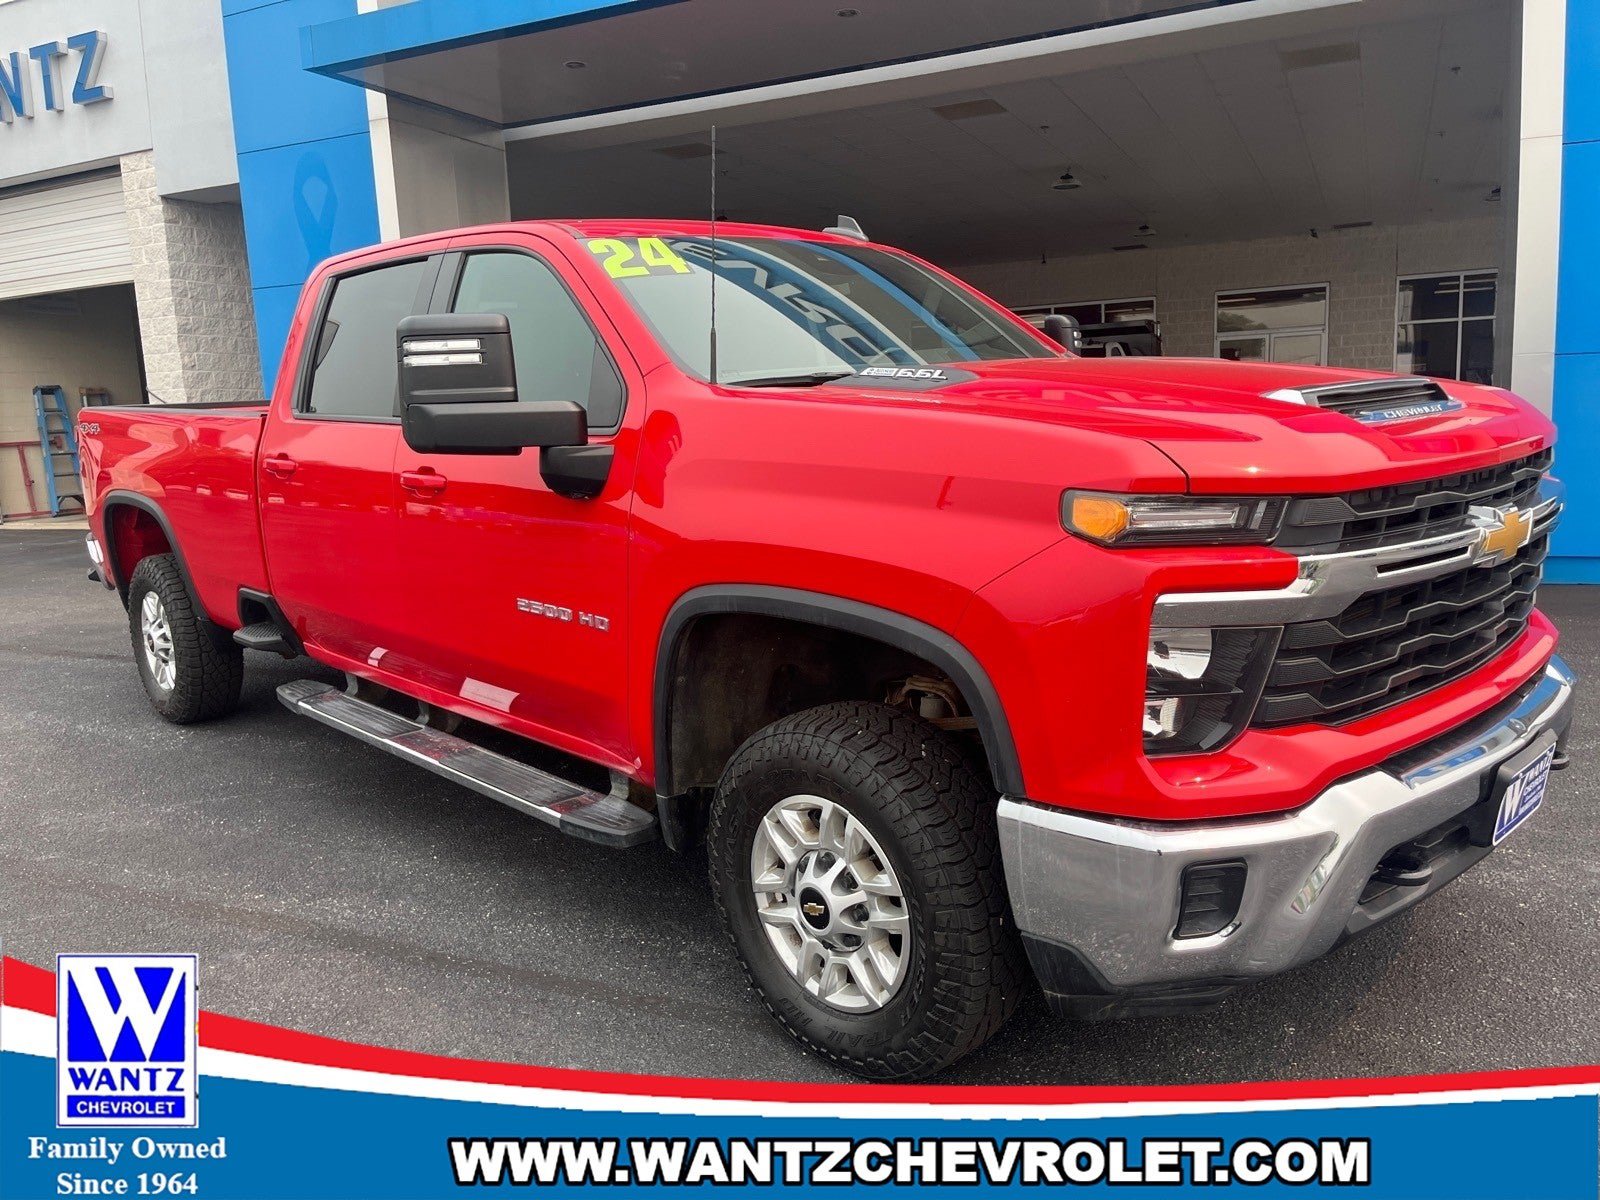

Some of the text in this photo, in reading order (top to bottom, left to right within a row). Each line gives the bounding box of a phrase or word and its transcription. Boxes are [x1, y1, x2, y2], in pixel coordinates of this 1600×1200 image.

[587, 237, 691, 279] 24
[1383, 404, 1442, 419] CHEVROLET
[516, 597, 610, 632] 2500 HD
